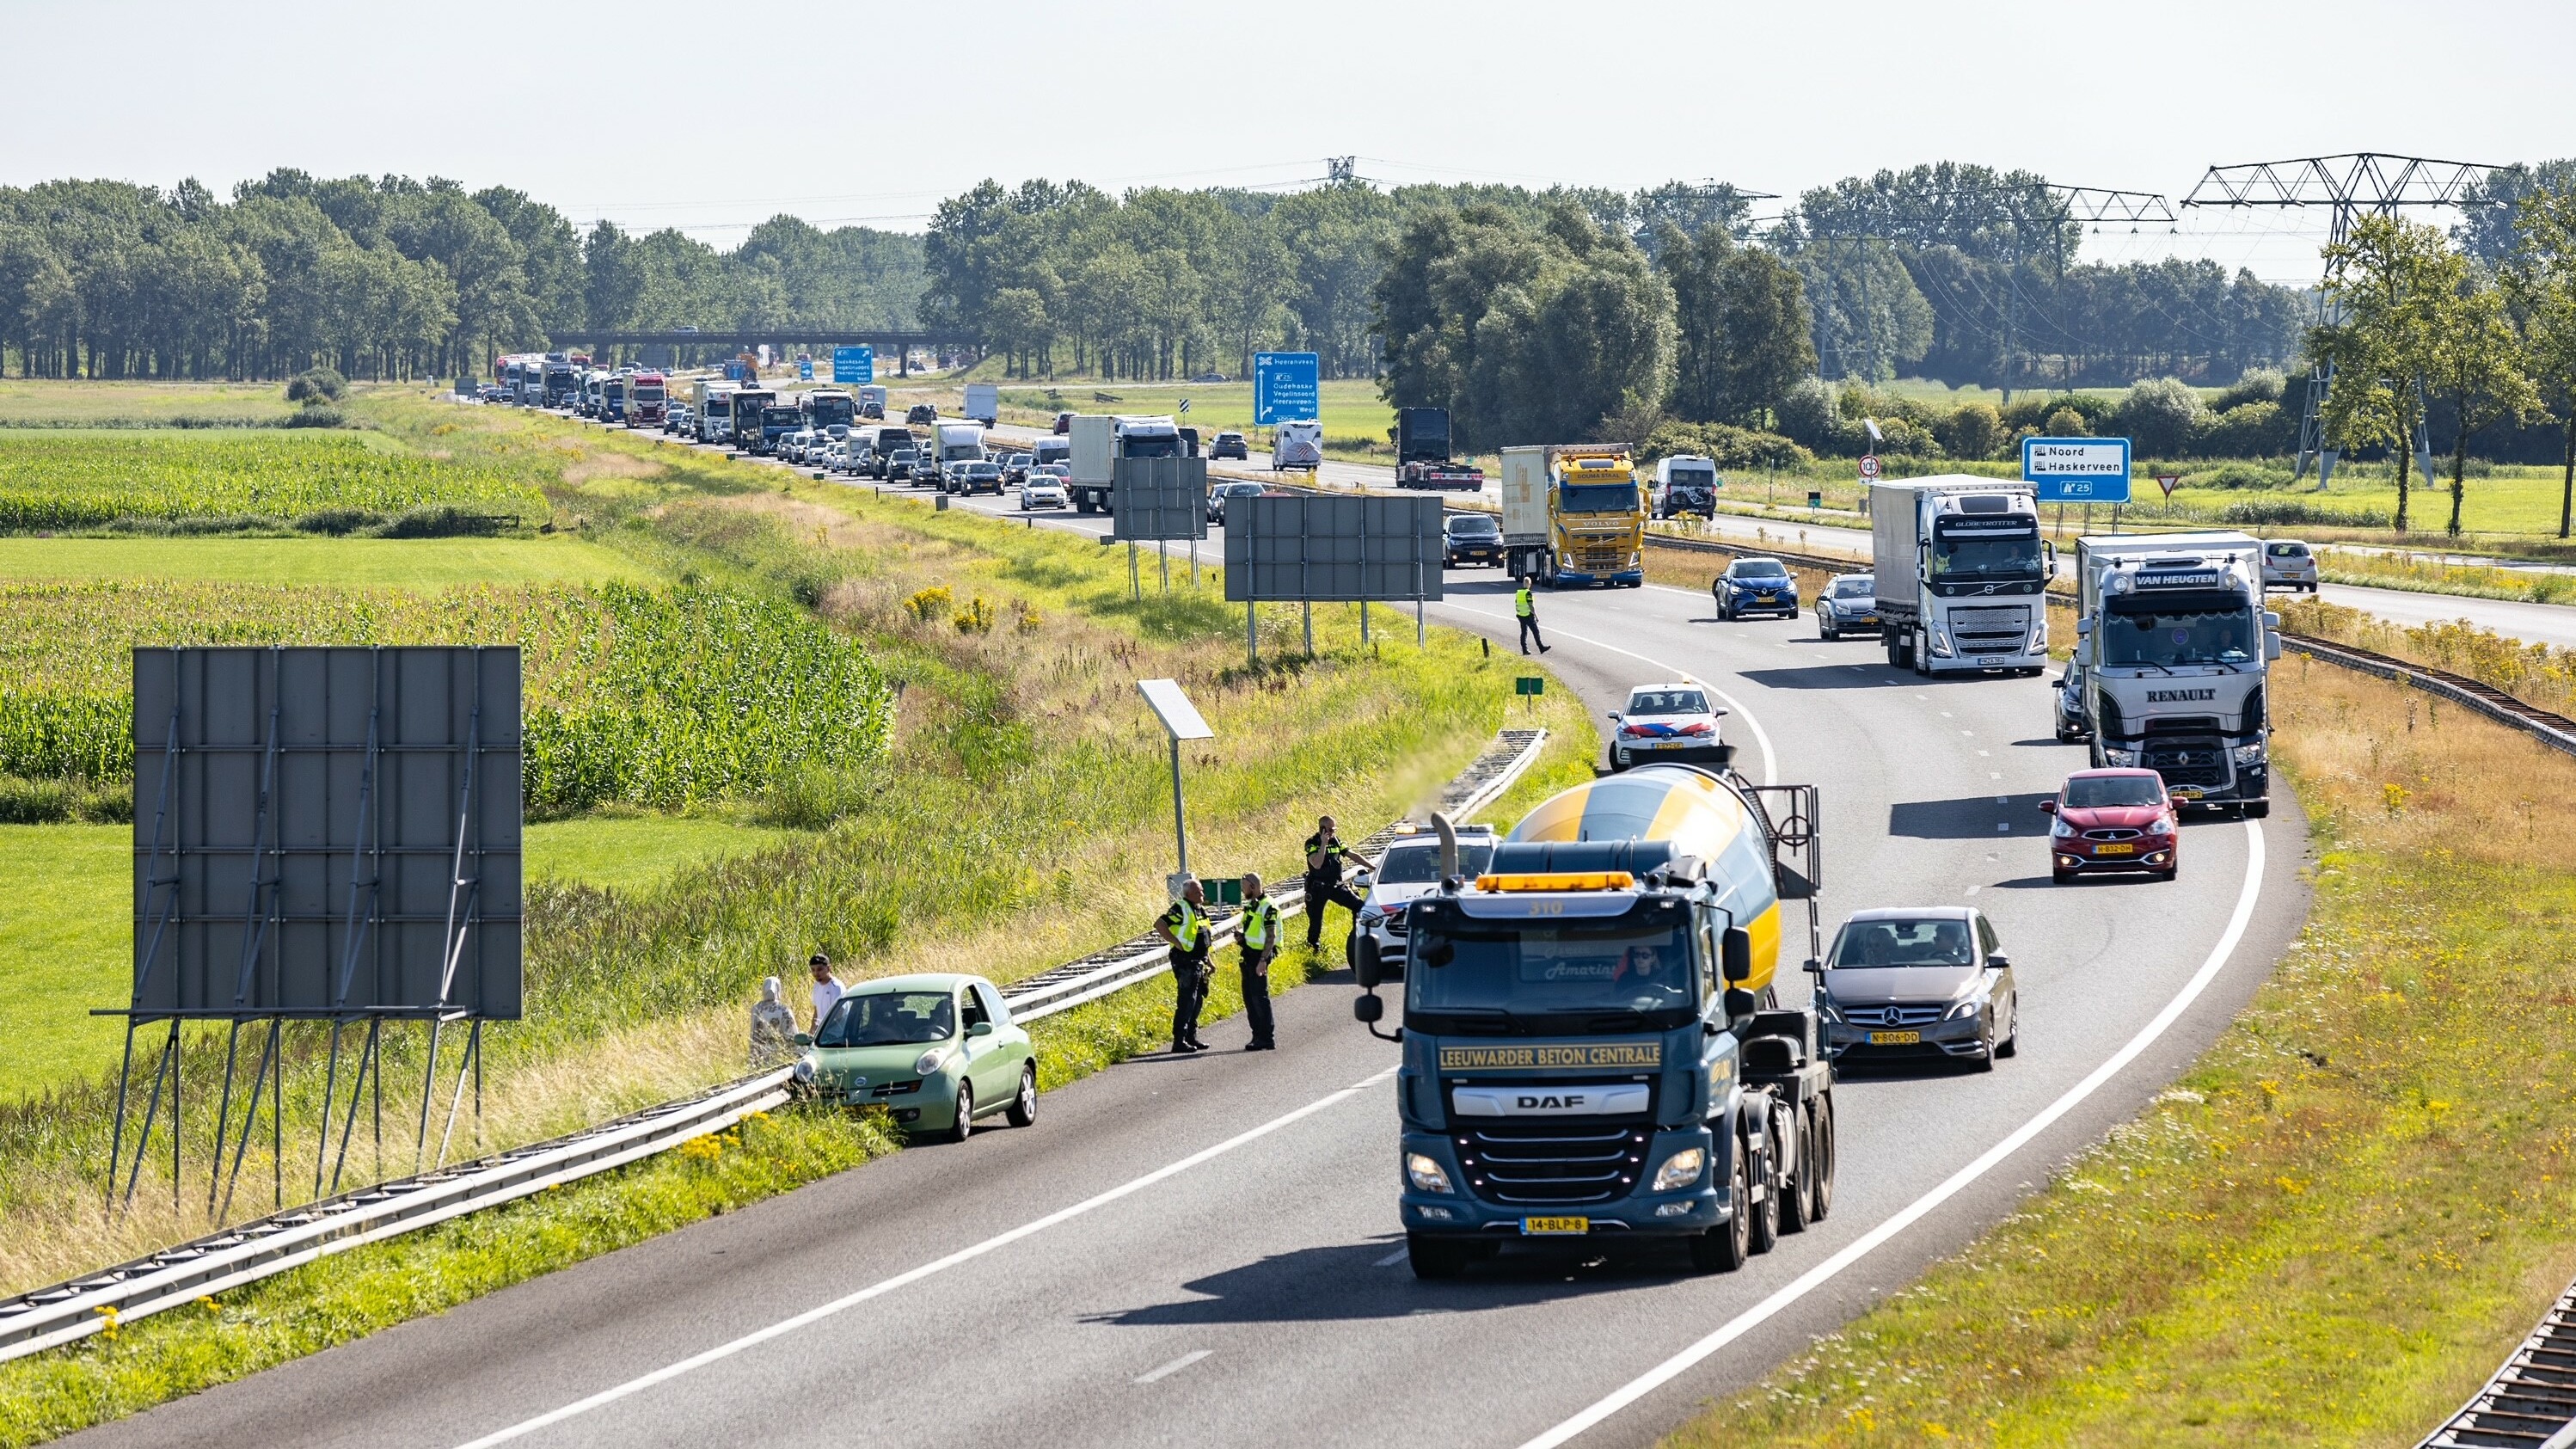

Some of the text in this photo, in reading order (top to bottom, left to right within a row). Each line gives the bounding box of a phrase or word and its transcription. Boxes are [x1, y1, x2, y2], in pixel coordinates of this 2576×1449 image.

[2049, 447, 2084, 456] Noord
[2136, 574, 2217, 585] VAN HEUGTEN
[2146, 689, 2216, 703] RENAULT
[1528, 901, 1563, 916] 310
[1873, 1033, 1918, 1041] N-806-DD
[1440, 1047, 1660, 1067] LEEUWARDER BETON CENTRALE
[1517, 1096, 1585, 1108] DAF
[1531, 1219, 1582, 1231] 14-BLP-8
